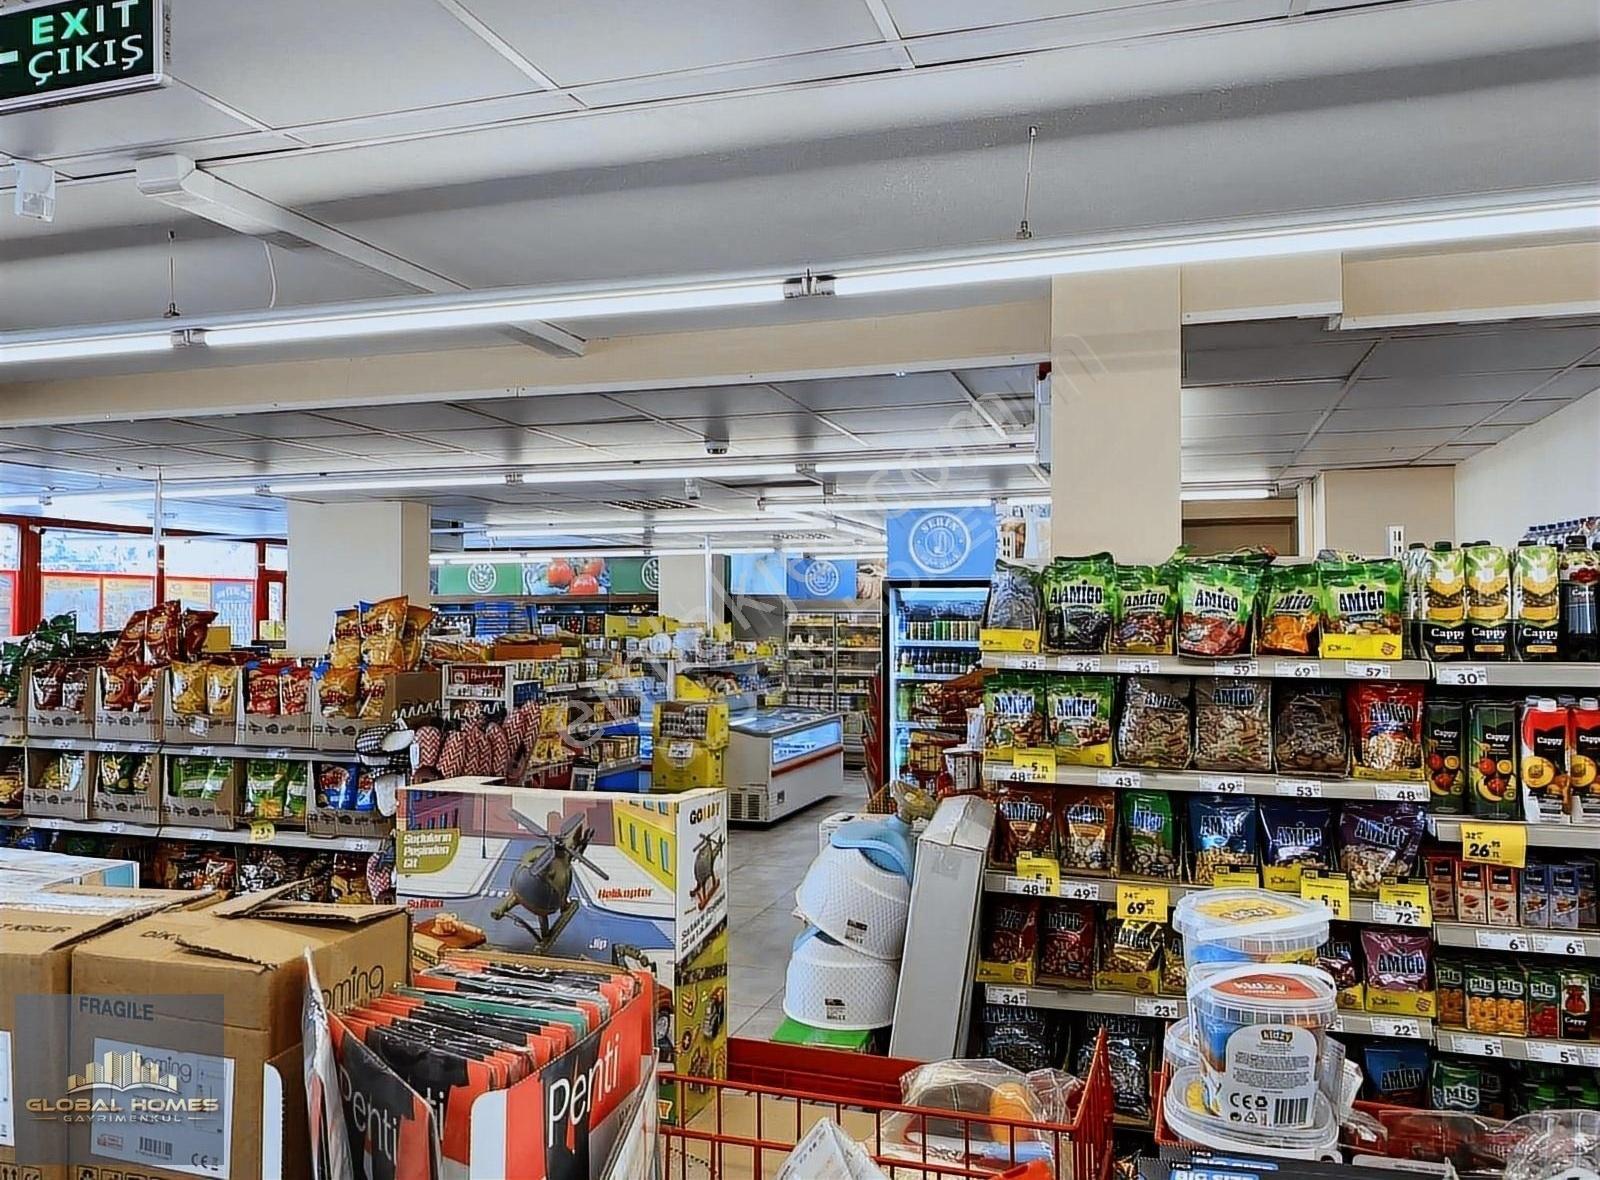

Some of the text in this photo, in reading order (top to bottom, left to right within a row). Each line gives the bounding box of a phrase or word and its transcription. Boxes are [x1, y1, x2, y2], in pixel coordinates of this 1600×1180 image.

[32, 0, 139, 46] EXIT
[28, 34, 144, 87] ÇIKIŞ
[1430, 627, 1465, 640] Cappy
[1471, 627, 1507, 639] Cappy
[1522, 627, 1558, 639] Cappy
[1457, 673, 1478, 685] 30
[1485, 733, 1511, 743] Cappy
[1537, 737, 1563, 747] Cappy
[1469, 843, 1490, 858] 26
[1126, 901, 1146, 915] 69
[1395, 911, 1413, 925] 72
[1509, 938, 1519, 950] 6
[1566, 942, 1576, 954] 6
[79, 996, 154, 1022] FRAGILE
[1393, 1024, 1412, 1036] 22
[1484, 1044, 1494, 1056] 5
[1560, 1051, 1570, 1063] 5
